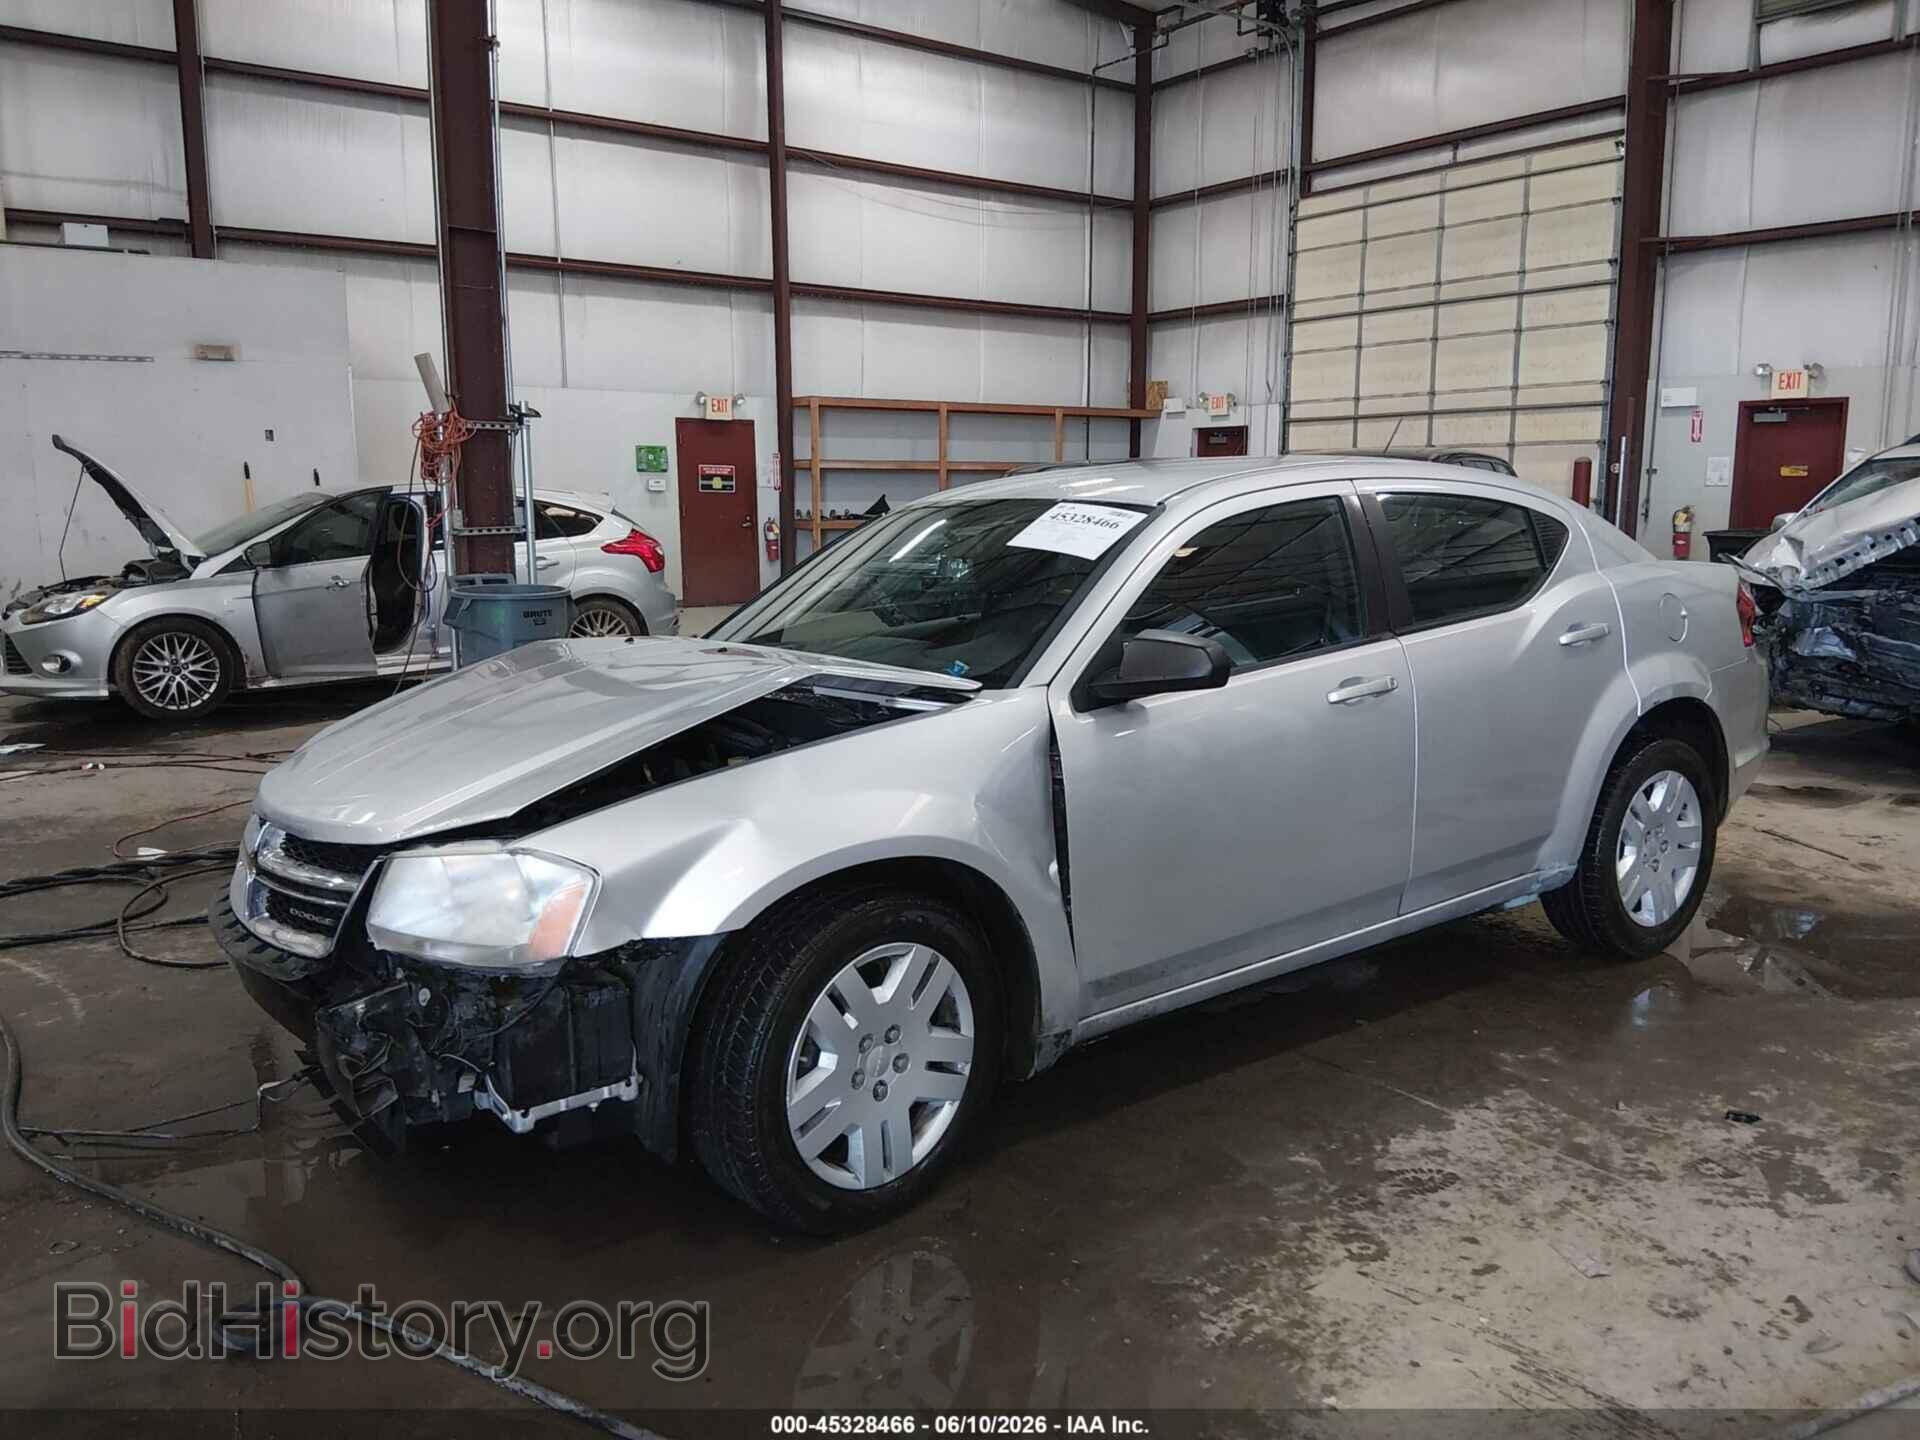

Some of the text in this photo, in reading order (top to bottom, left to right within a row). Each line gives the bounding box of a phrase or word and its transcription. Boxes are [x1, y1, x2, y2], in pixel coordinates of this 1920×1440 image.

[1777, 372, 1802, 390] EXIT
[711, 398, 728, 413] EXIT
[1211, 396, 1224, 409] EXIT
[1049, 511, 1120, 530] 45328466
